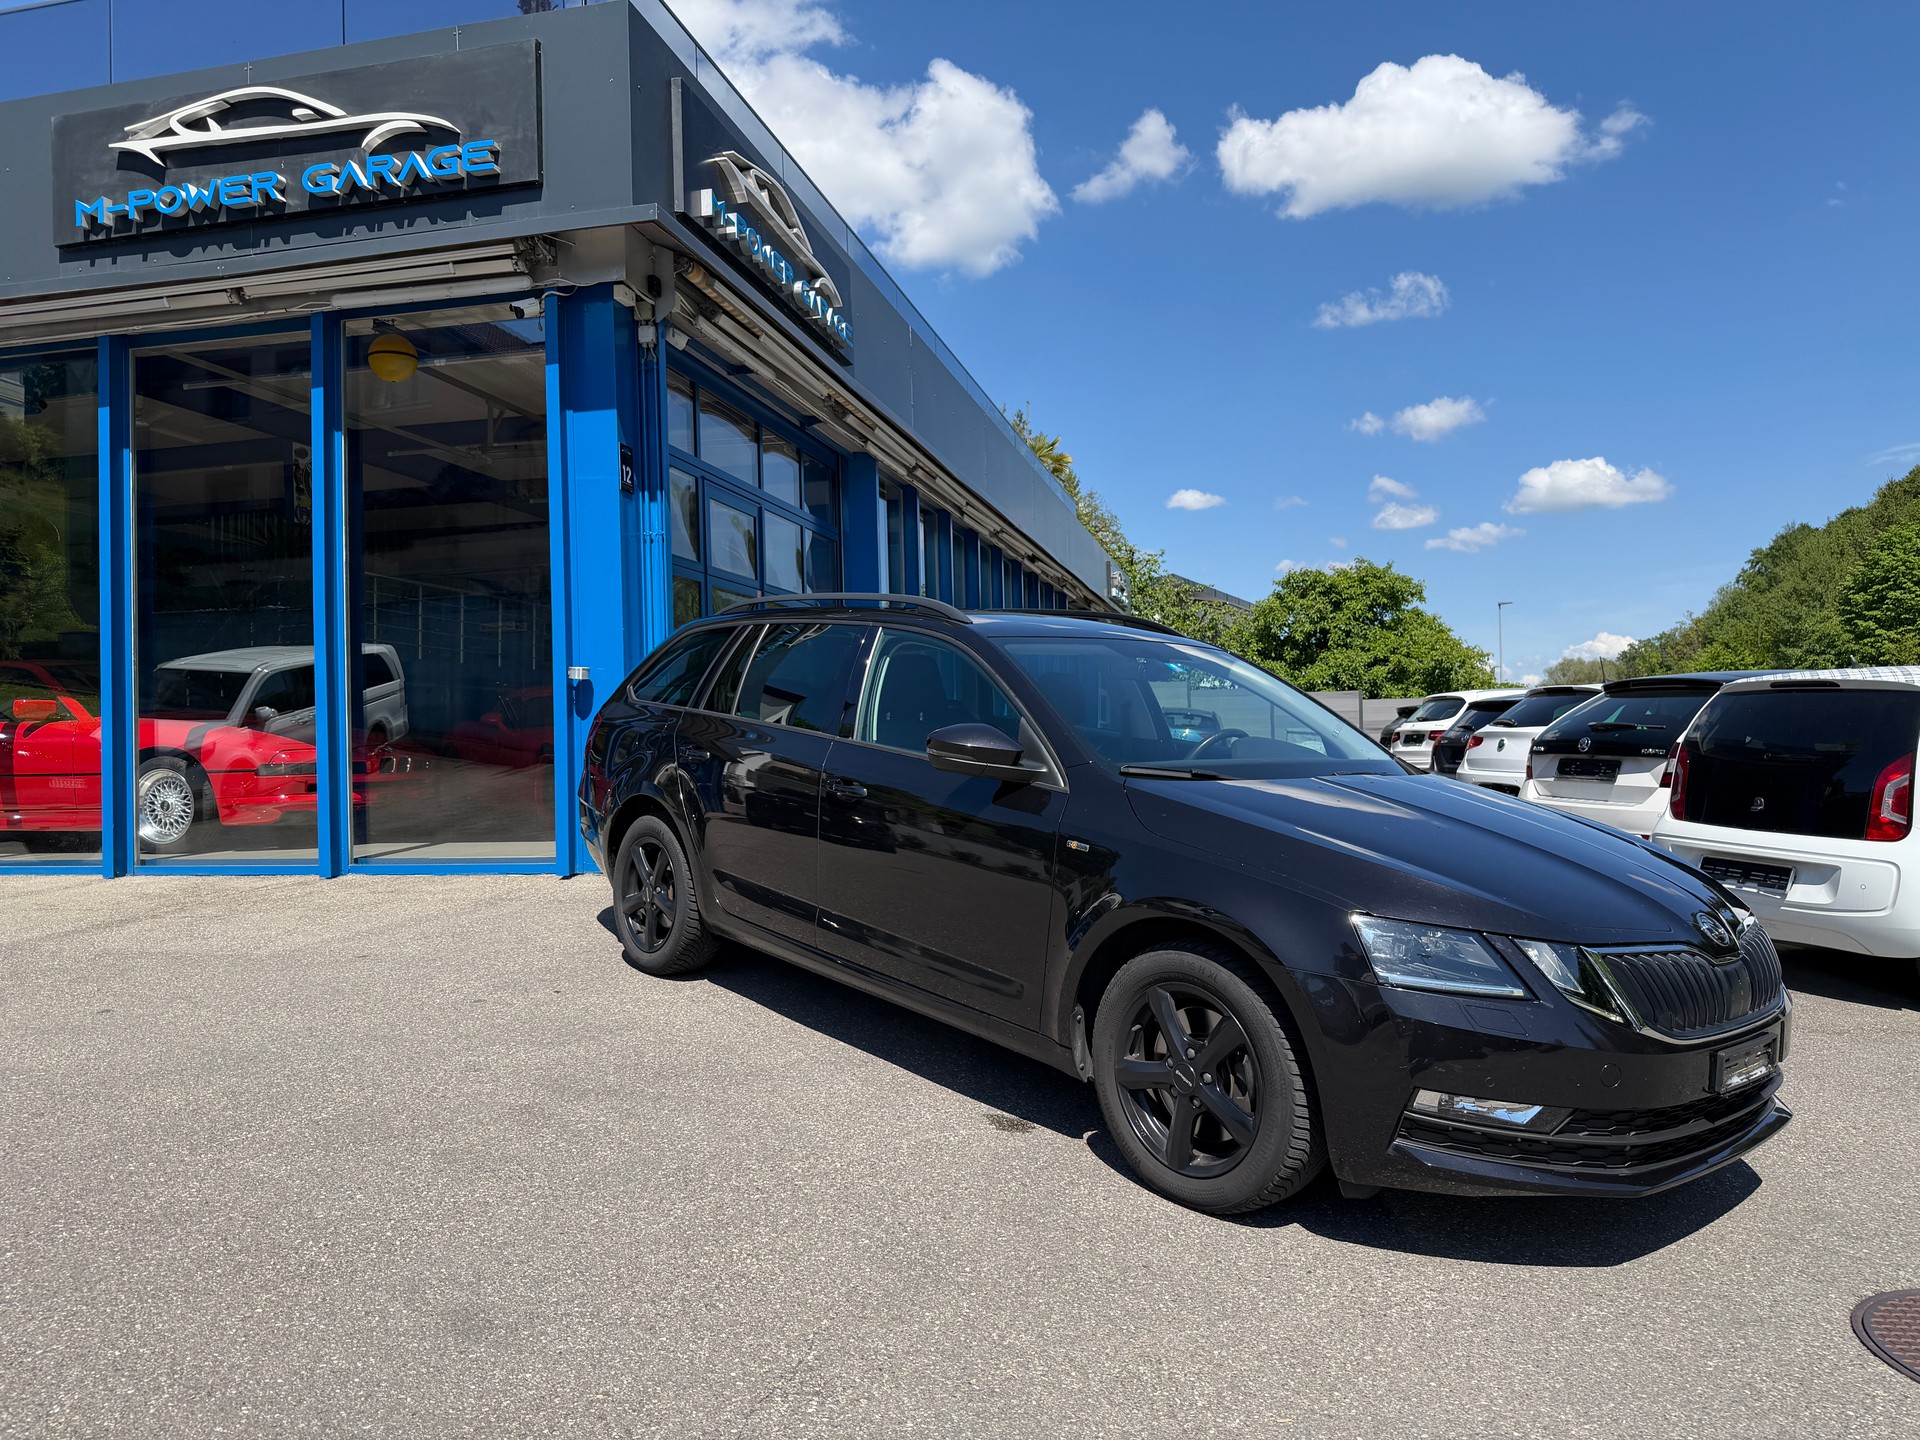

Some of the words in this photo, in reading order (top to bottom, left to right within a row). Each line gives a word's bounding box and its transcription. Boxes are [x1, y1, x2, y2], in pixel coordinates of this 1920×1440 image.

[75, 170, 284, 229] M-POWER
[301, 139, 499, 196] GARAGE
[704, 188, 795, 287] M-POWER
[622, 464, 632, 484] 12
